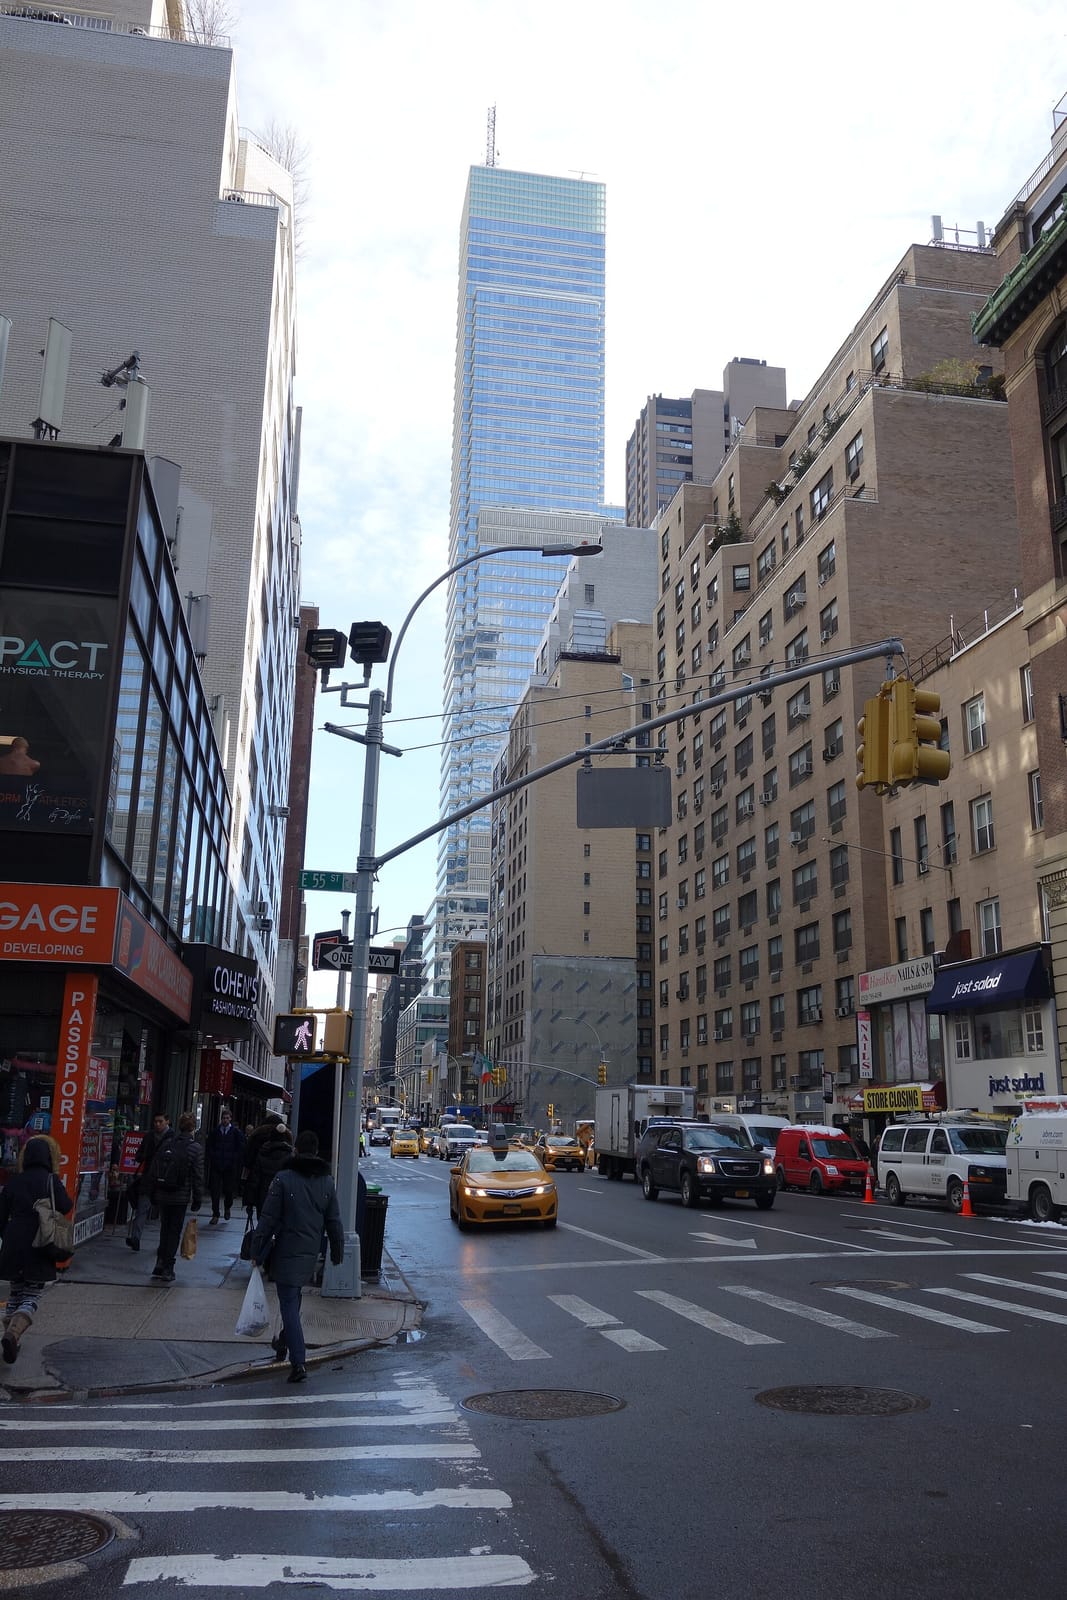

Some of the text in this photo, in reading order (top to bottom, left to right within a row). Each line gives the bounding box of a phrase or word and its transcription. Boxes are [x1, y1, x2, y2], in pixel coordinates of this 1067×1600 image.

[52, 669, 105, 680] THERAPY
[301, 872, 341, 889] E 55 ST
[0, 901, 98, 934] GAGE
[3, 942, 84, 956] DEVELOPING
[331, 951, 353, 964] ONE
[897, 965, 915, 981] NAILS
[921, 962, 933, 977] SPA
[214, 965, 258, 1003] COHEN'S
[951, 972, 1002, 999] just salad
[212, 999, 257, 1022] FASHION OPTICAL
[860, 1023, 871, 1070] NAILS
[60, 991, 85, 1134] PASSPORT
[988, 1072, 1045, 1097] just salad
[866, 1092, 888, 1109] STORE
[888, 1089, 919, 1108] CLOSING
